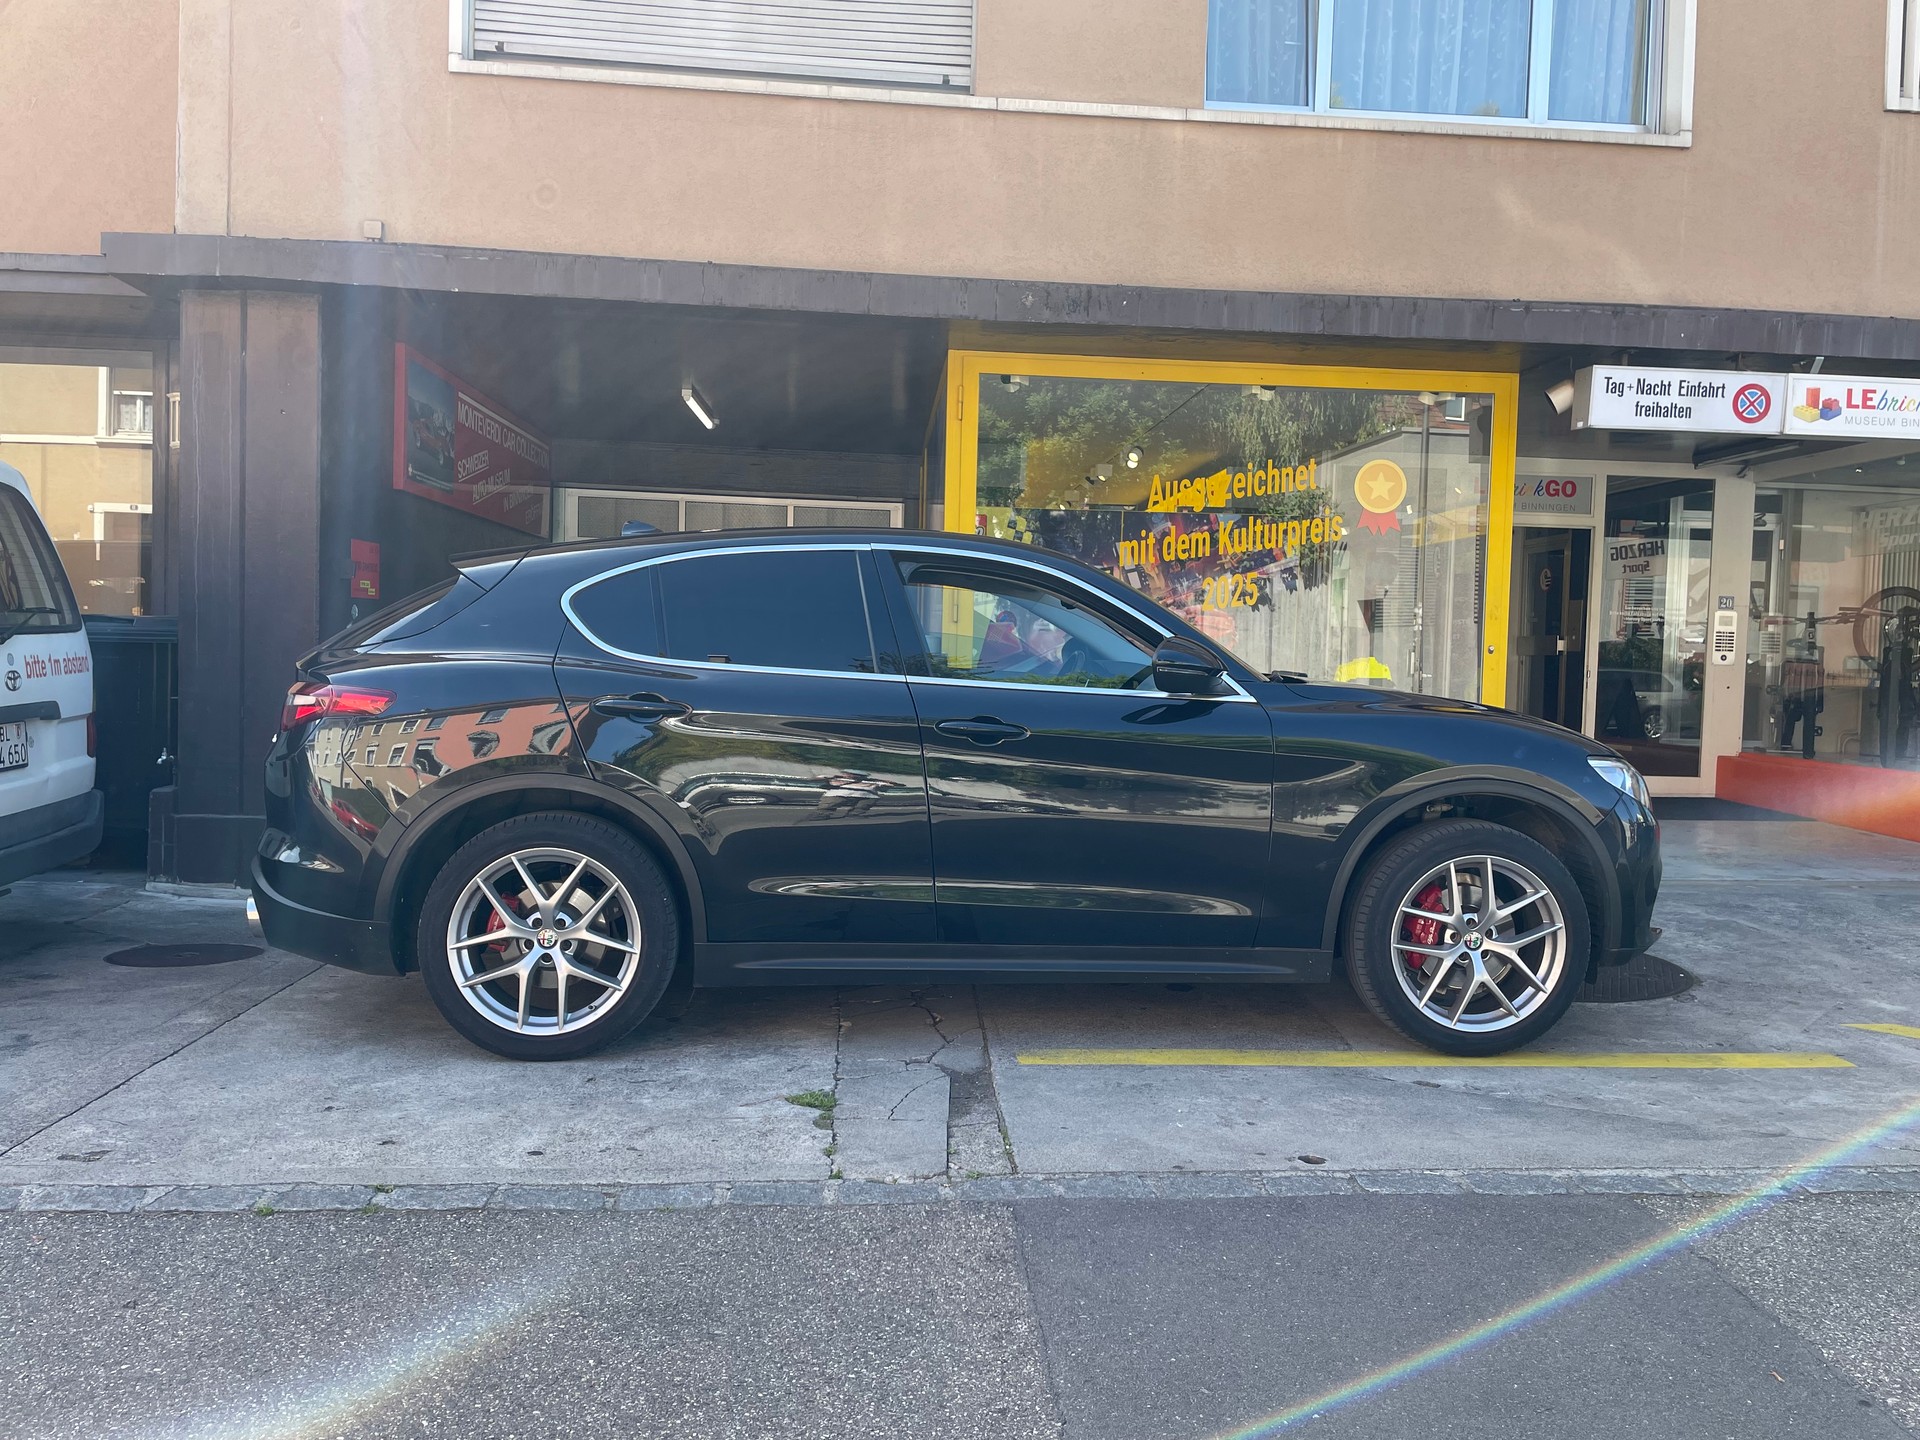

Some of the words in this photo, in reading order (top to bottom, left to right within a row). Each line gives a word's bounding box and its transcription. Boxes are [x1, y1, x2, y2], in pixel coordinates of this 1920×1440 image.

[1605, 377, 1624, 397] Tag
[1636, 378, 1672, 396] Nacht
[1678, 380, 1726, 398] Einfahrt
[1635, 401, 1692, 419] freihalten
[1846, 388, 1920, 412] LEbric
[1845, 416, 1896, 427] MUSEUM
[458, 401, 502, 444] MONTEVERDI
[502, 429, 516, 452] CAR
[515, 436, 549, 469] COLLECTION
[458, 450, 489, 478] SCHWEIZER
[472, 468, 511, 501] AUTO-MUSEUM
[1521, 502, 1576, 512] BINNINGEN
[1858, 505, 1920, 530] HERZ
[1119, 529, 1156, 567] mit
[1162, 525, 1211, 562] dem
[1218, 506, 1343, 558] Kulturpreis
[1201, 572, 1259, 611] 2025
[1720, 597, 1733, 608] 20
[24, 654, 47, 679] bitte
[48, 653, 62, 676] 1m
[63, 651, 90, 675] abstand
[8, 743, 26, 765] 650
